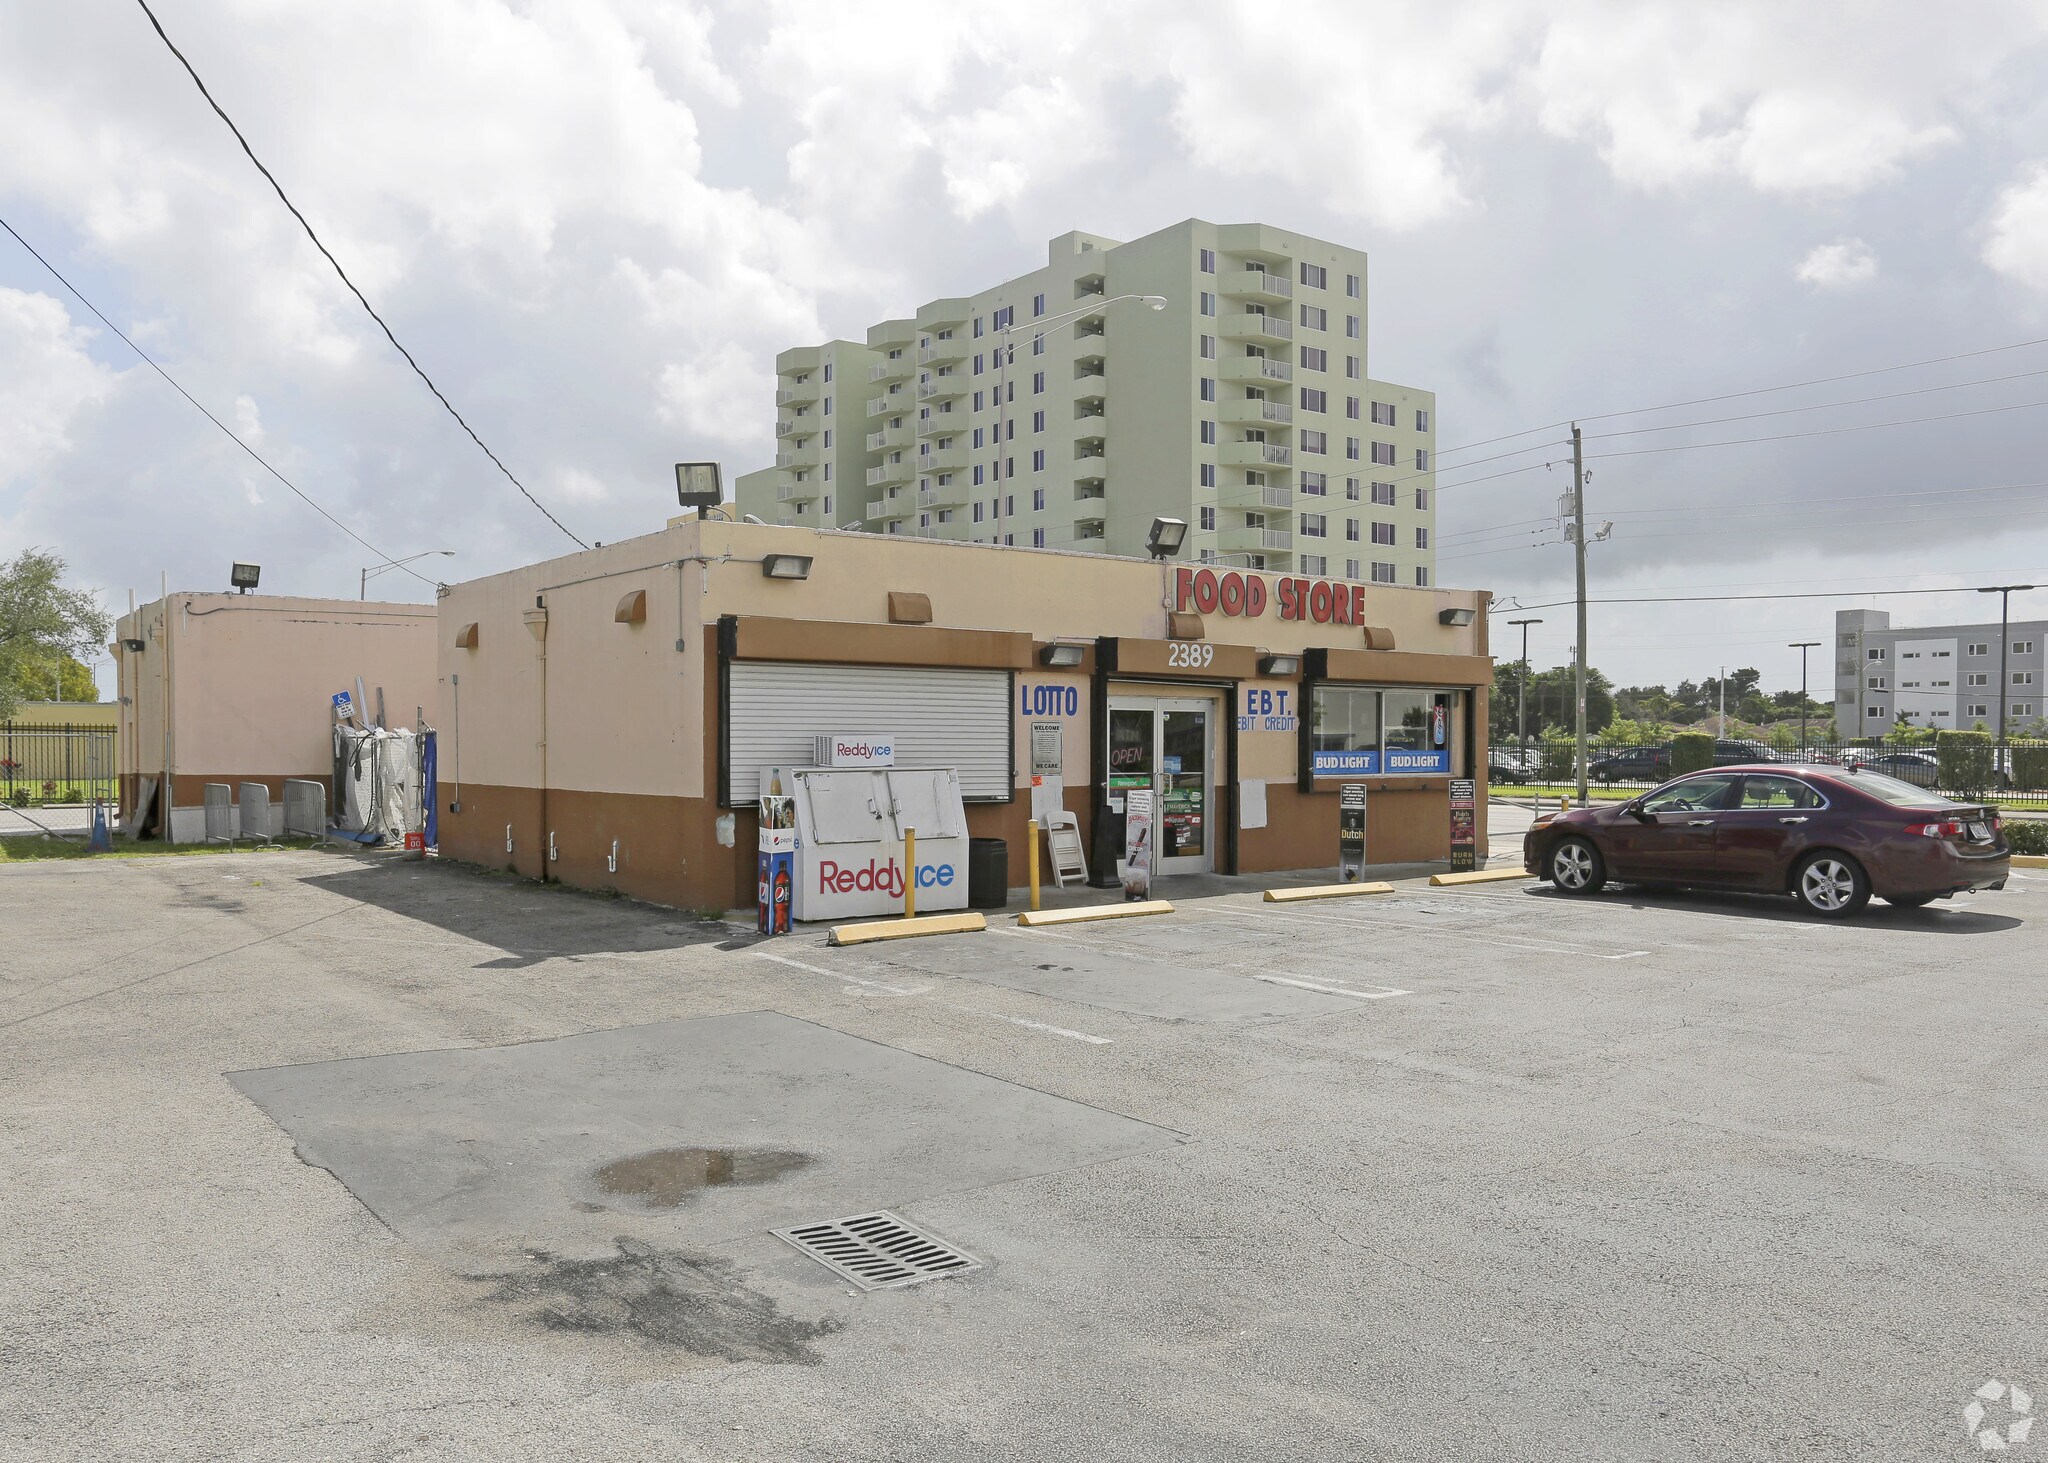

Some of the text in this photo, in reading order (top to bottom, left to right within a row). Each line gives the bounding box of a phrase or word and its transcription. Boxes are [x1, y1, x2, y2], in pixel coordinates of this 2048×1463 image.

[1173, 567, 1365, 626] FOOD STORE
[1168, 643, 1214, 668] 2389
[1022, 685, 1077, 716] LOTTO
[1238, 716, 1295, 731] EBIT CREDIT
[1111, 747, 1143, 766] OPEN
[1316, 756, 1370, 769] BUD LIGHT
[1390, 755, 1440, 767] BUD LIGHT
[1342, 830, 1364, 839] Dutch
